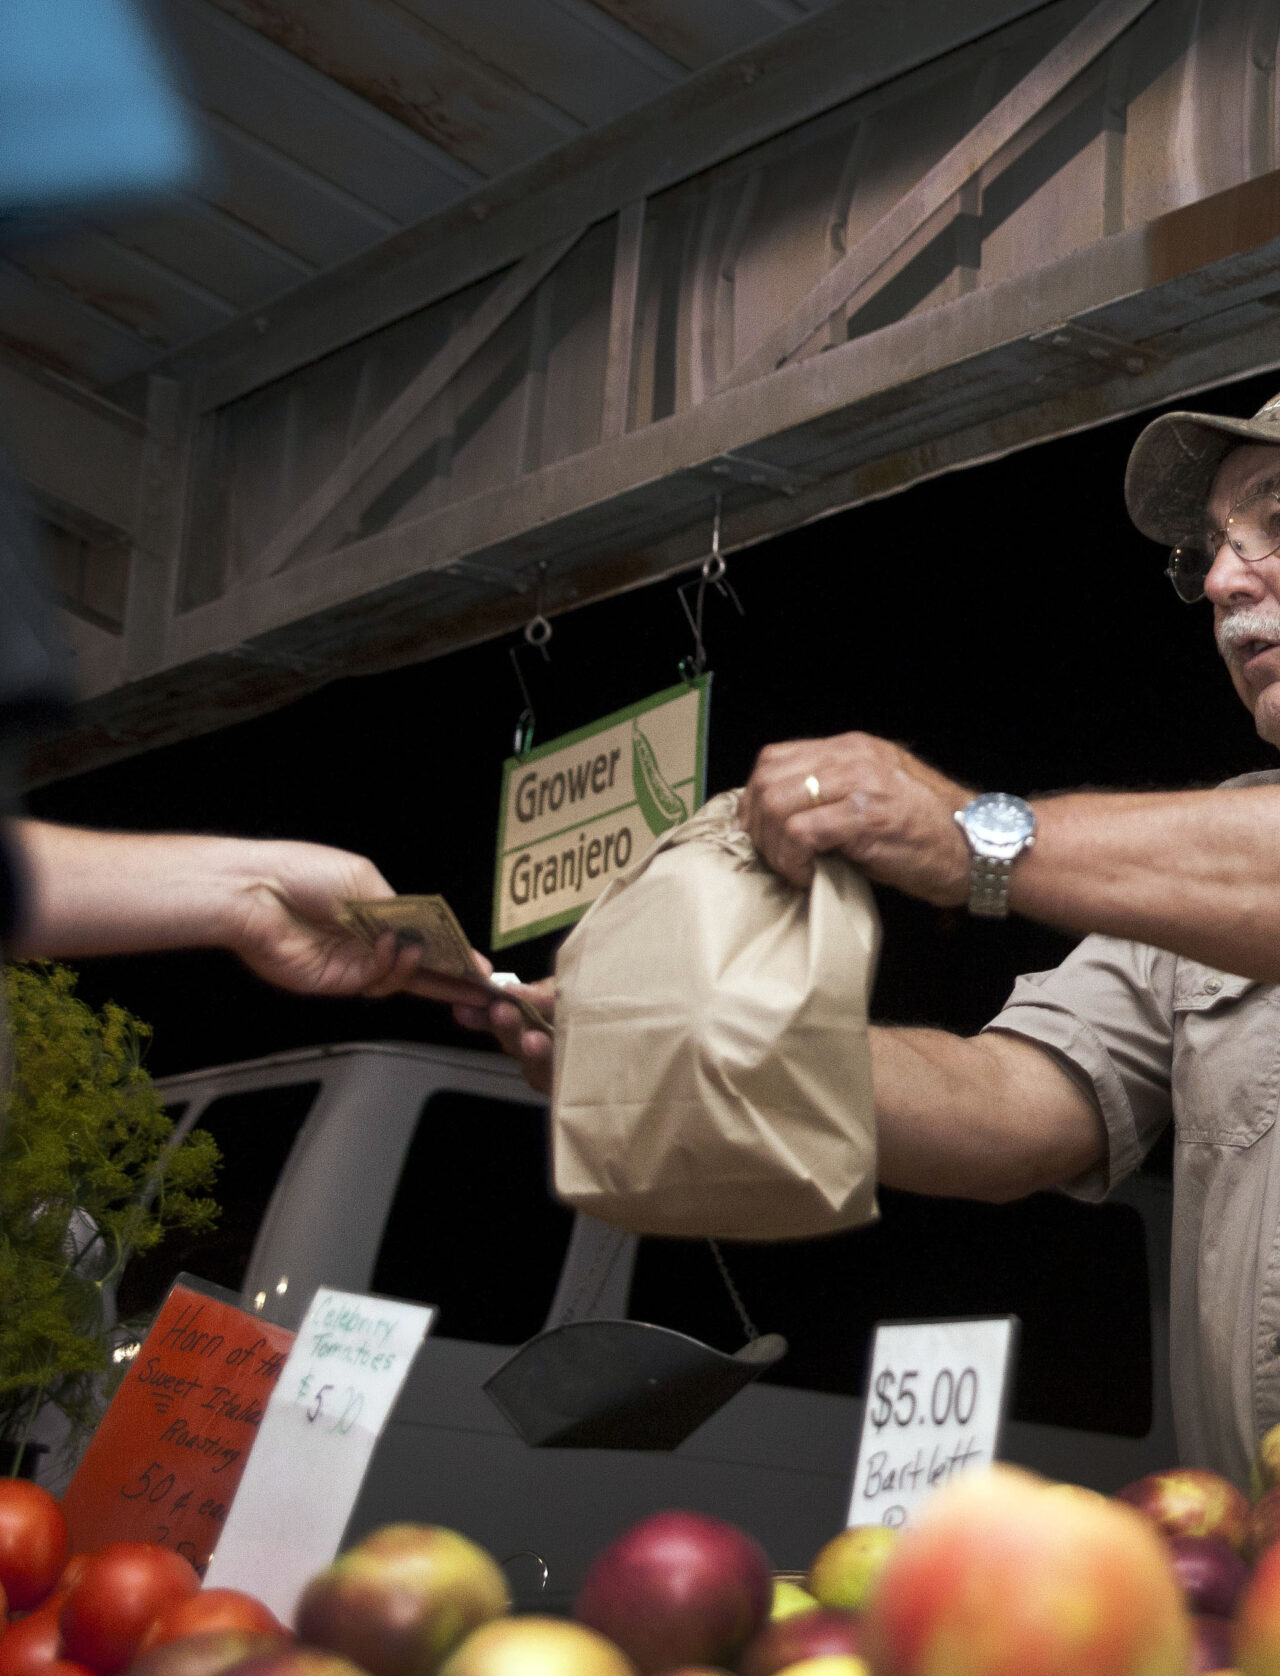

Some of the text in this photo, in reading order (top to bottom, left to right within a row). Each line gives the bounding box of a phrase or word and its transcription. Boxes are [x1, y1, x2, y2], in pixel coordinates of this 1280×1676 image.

[515, 747, 621, 823] Grower
[510, 827, 632, 905] Granjero
[159, 1303, 286, 1380] Horn of th
[138, 1357, 262, 1426] Sweet Italia
[870, 1363, 978, 1433] $5.00
[159, 1418, 240, 1473] Roasting
[863, 1436, 984, 1500] Bartlett
